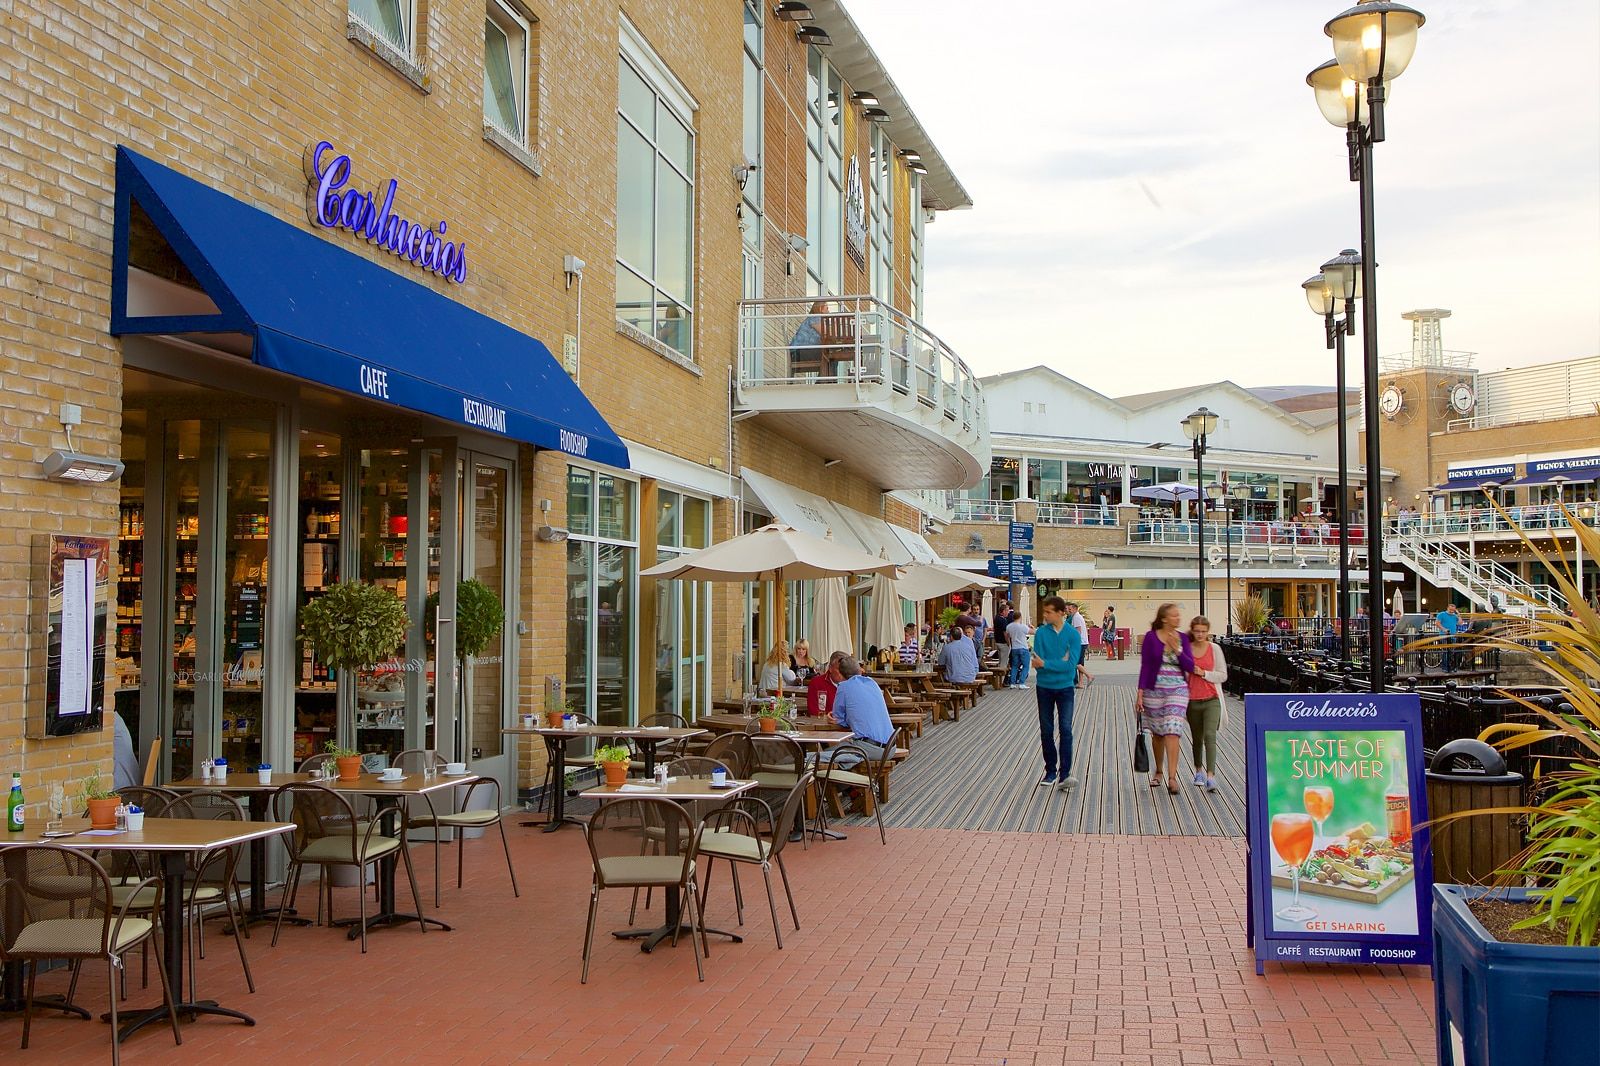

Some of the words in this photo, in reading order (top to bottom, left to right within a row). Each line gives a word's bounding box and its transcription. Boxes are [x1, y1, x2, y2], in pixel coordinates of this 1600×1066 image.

[463, 398, 506, 434] RESTAURANT
[559, 428, 589, 457] FOODSHOP
[1448, 470, 1473, 479] SIGNOR
[1474, 466, 1514, 477] VALENTINO
[1536, 461, 1565, 471] SIGNOR
[1566, 458, 1600, 469] VALENTI
[1286, 700, 1378, 719] Carluccio's
[1288, 739, 1349, 759] TASTE
[1355, 739, 1385, 758] OF
[1292, 760, 1384, 779] SUMMER
[1306, 921, 1327, 931] GET
[1332, 922, 1386, 932] SHARING
[1309, 947, 1362, 957] RESTAURANT
[1370, 949, 1417, 959] FOODSHOP
